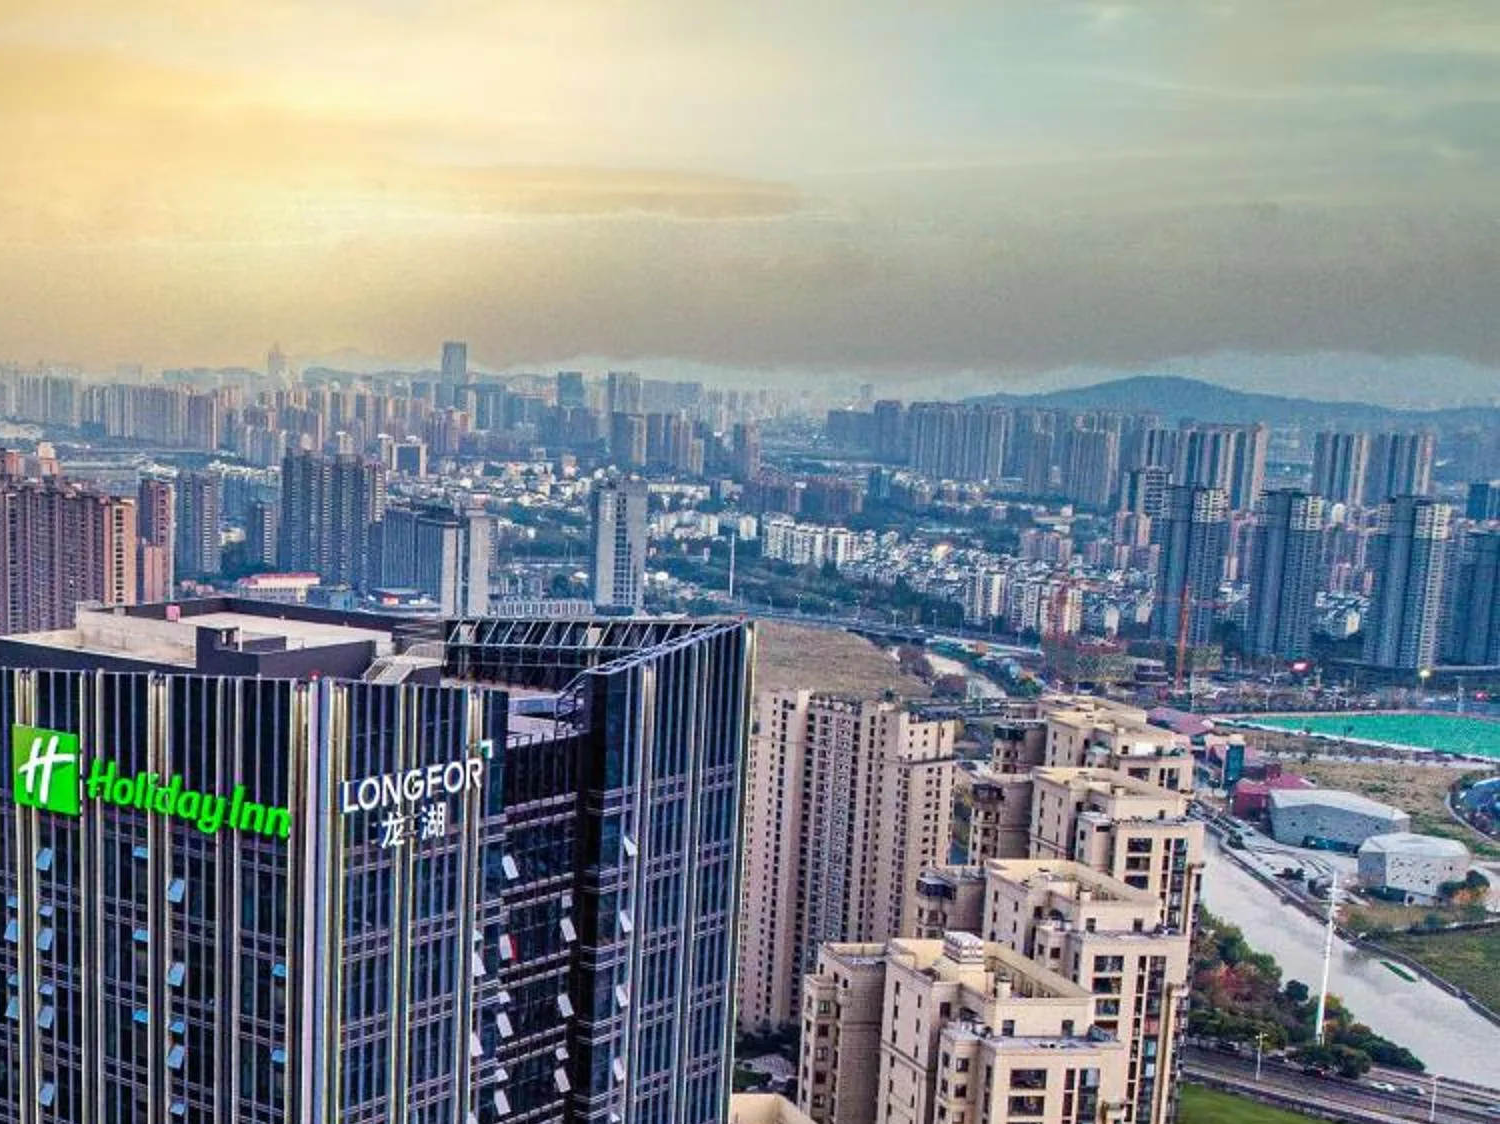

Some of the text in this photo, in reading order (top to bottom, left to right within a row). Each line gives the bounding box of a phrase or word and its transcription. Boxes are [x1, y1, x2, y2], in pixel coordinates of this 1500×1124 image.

[86, 757, 292, 838] Holiday Inn
[343, 757, 484, 814] LONGFOR
[381, 801, 447, 849] 龙湖
